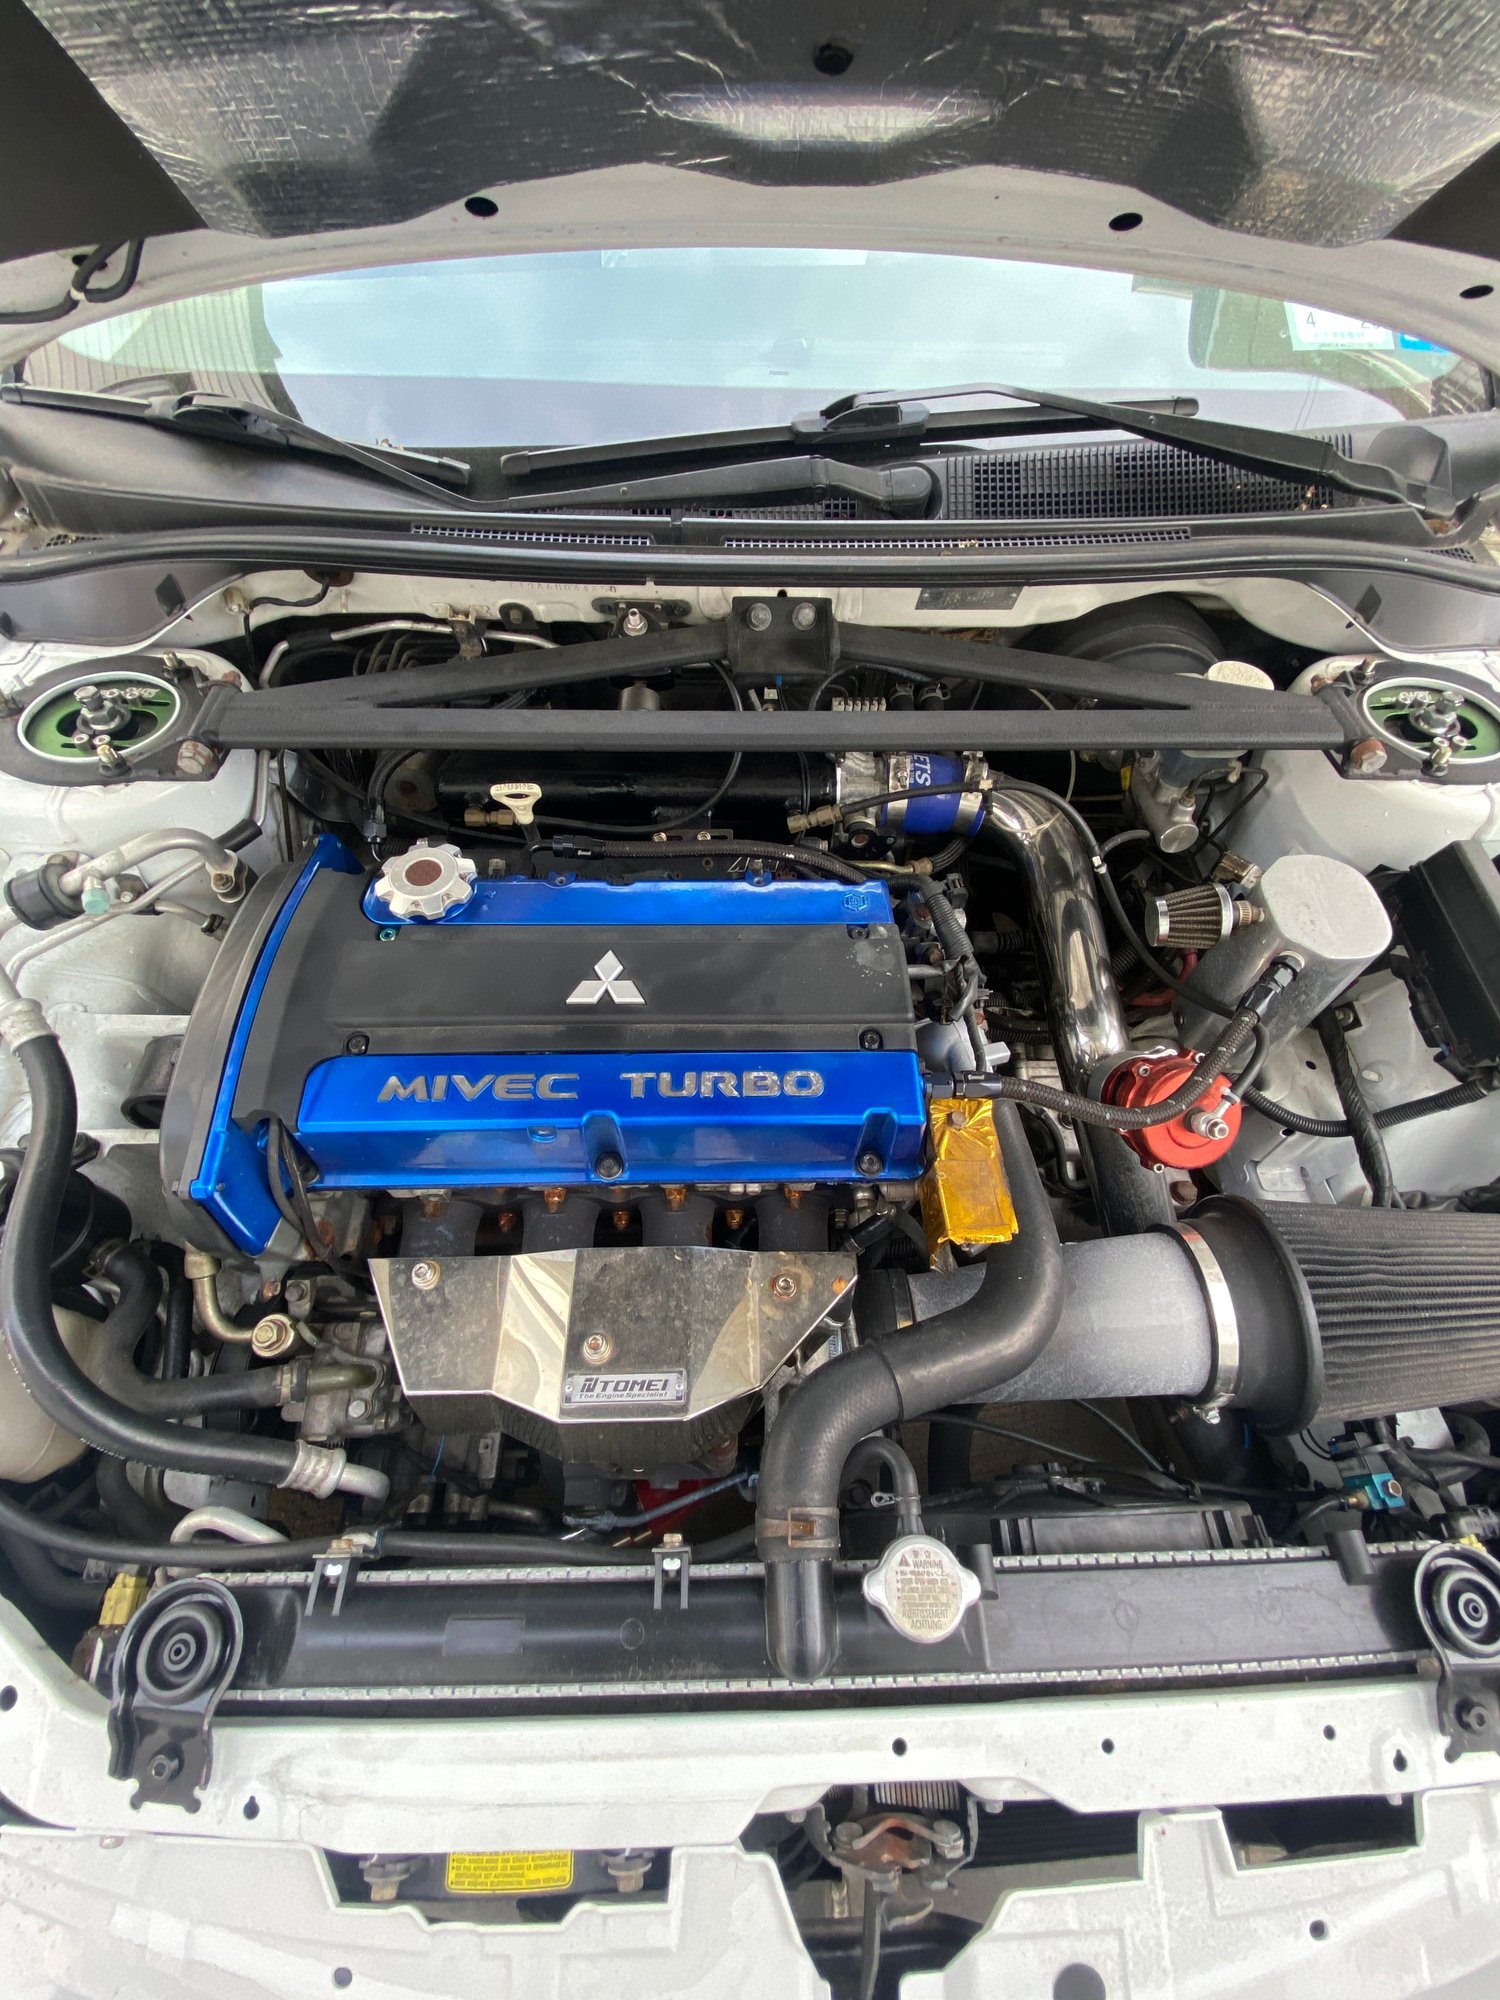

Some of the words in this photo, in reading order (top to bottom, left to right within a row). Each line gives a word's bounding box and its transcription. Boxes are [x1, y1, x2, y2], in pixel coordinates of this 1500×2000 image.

[1306, 311, 1317, 328] 4
[913, 754, 932, 787] ETS
[377, 1072, 580, 1102] MIVEC
[619, 1069, 825, 1099] TURBO
[600, 1379, 670, 1392] TOMEI
[595, 1392, 624, 1400] Engine
[624, 1391, 668, 1399] Specialist
[912, 1559, 944, 1570] WARNING
[910, 1619, 942, 1630] ACHTUNG
